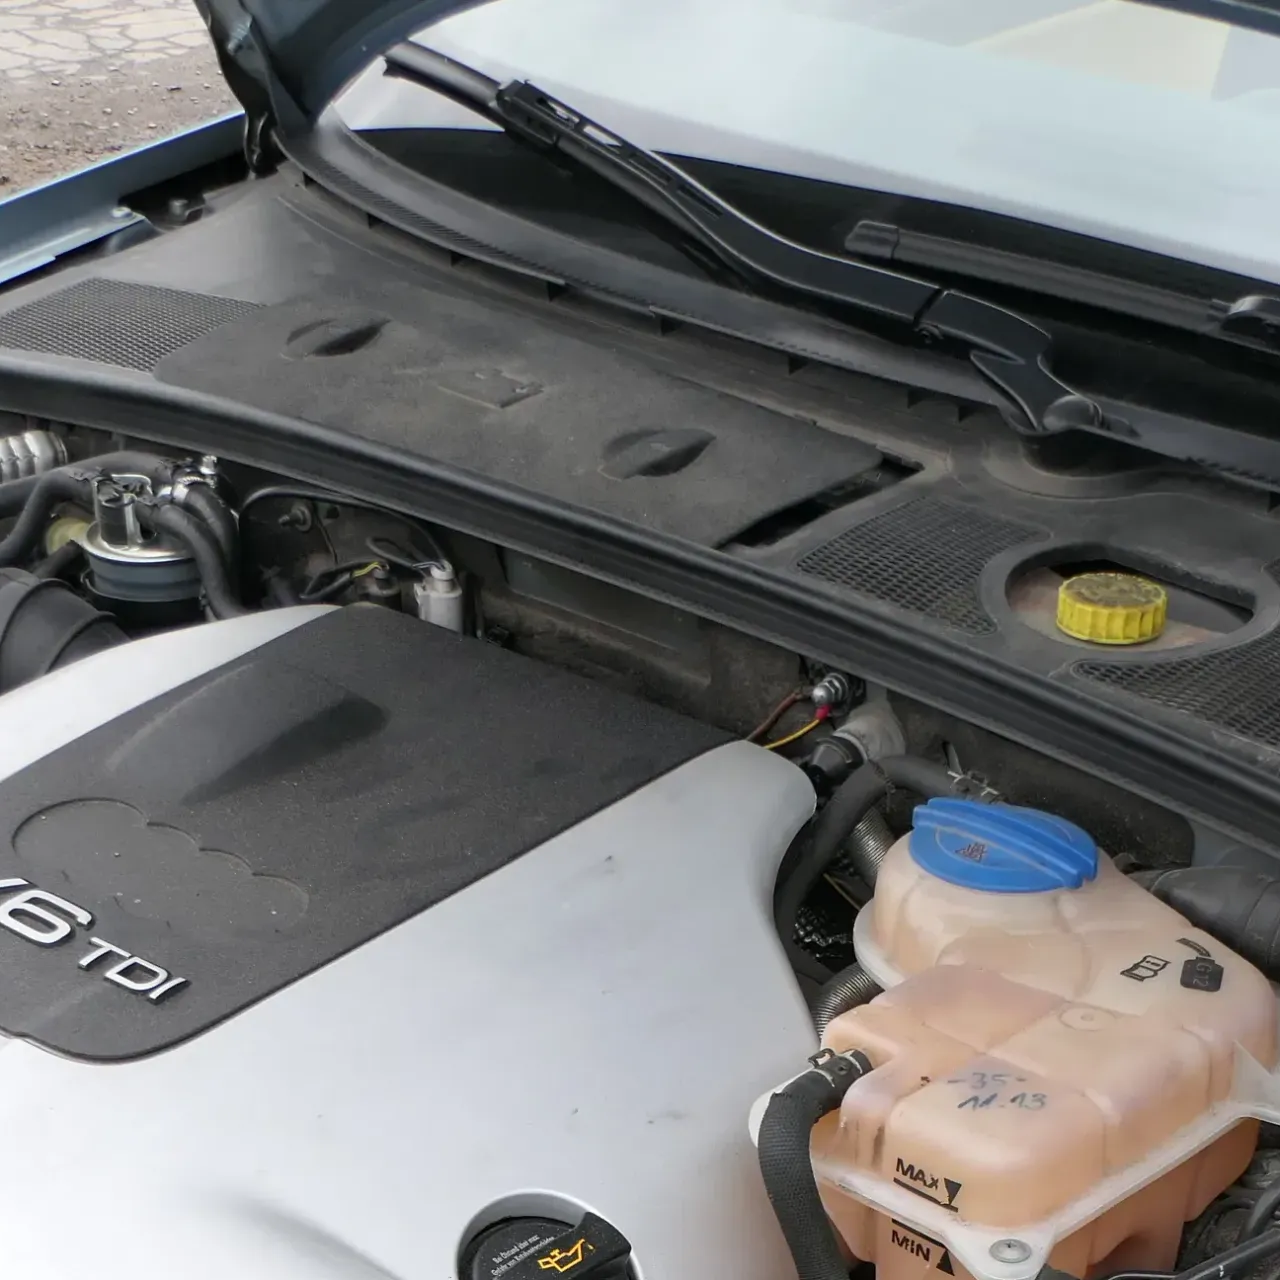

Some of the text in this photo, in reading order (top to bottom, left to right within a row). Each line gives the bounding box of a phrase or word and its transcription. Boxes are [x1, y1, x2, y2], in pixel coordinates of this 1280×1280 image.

[78, 936, 189, 1002] TDI
[896, 1157, 939, 1190] MAX
[891, 1229, 930, 1262] MIN
